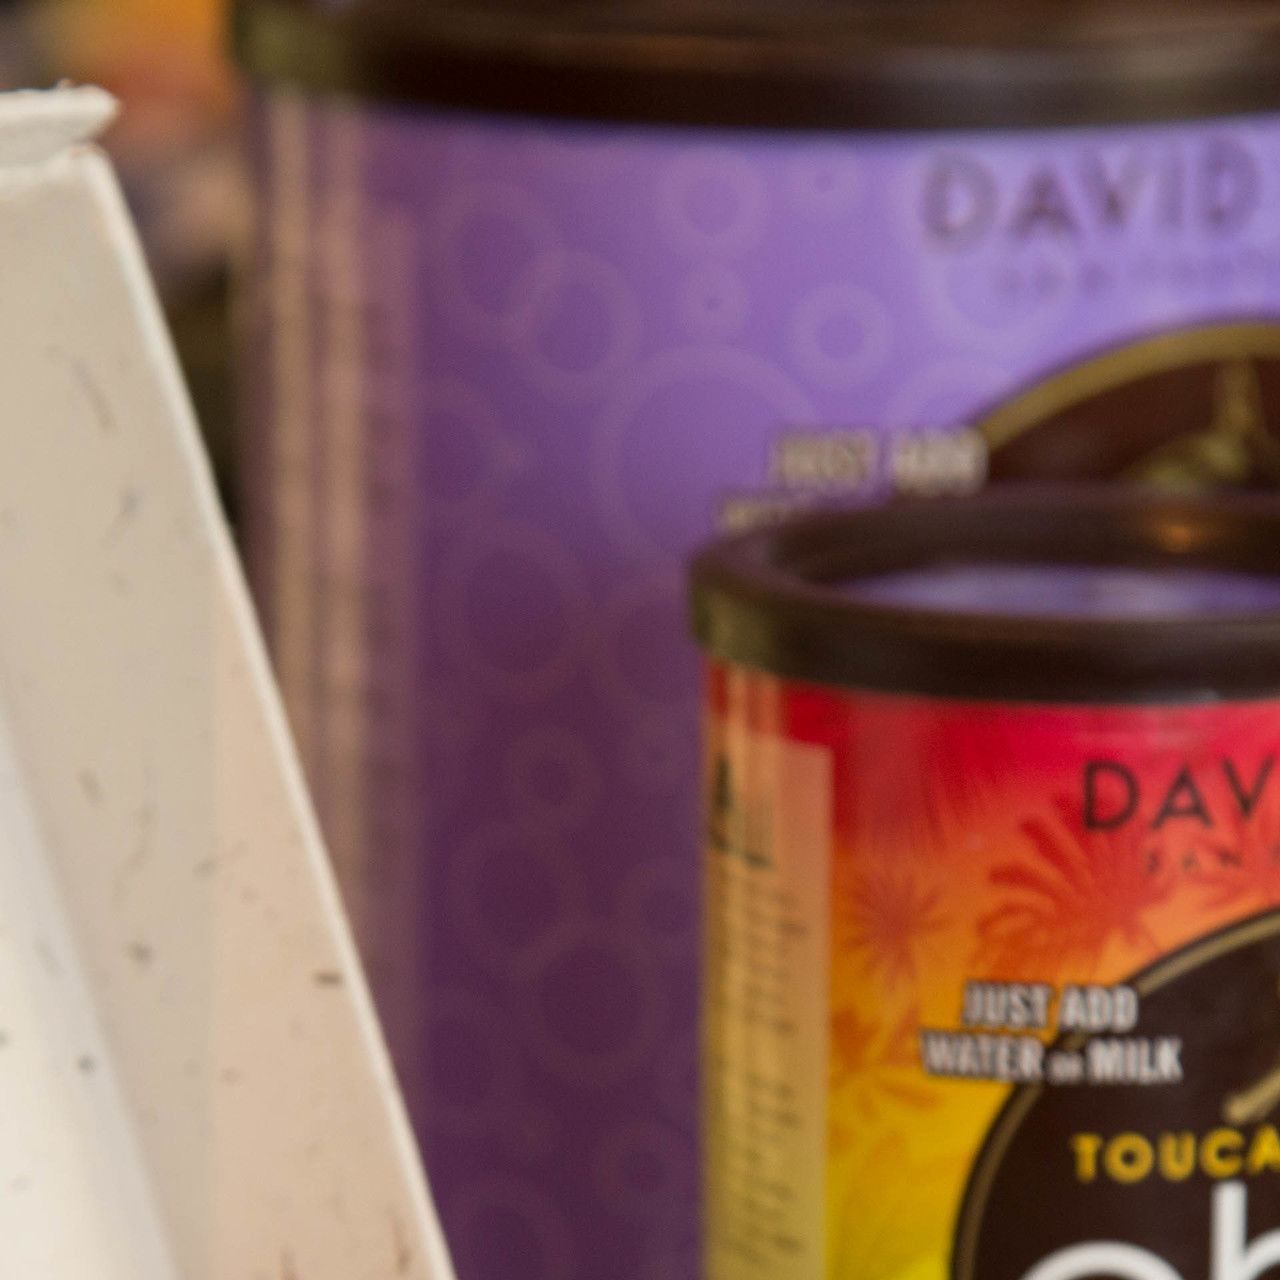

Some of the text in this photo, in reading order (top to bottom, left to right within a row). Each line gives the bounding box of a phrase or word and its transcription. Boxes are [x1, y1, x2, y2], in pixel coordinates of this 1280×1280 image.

[922, 130, 1262, 252] DAVID
[962, 981, 1139, 1034] JUST ADD
[922, 1030, 1046, 1083] WATER
[1086, 1036, 1184, 1086] MILK
